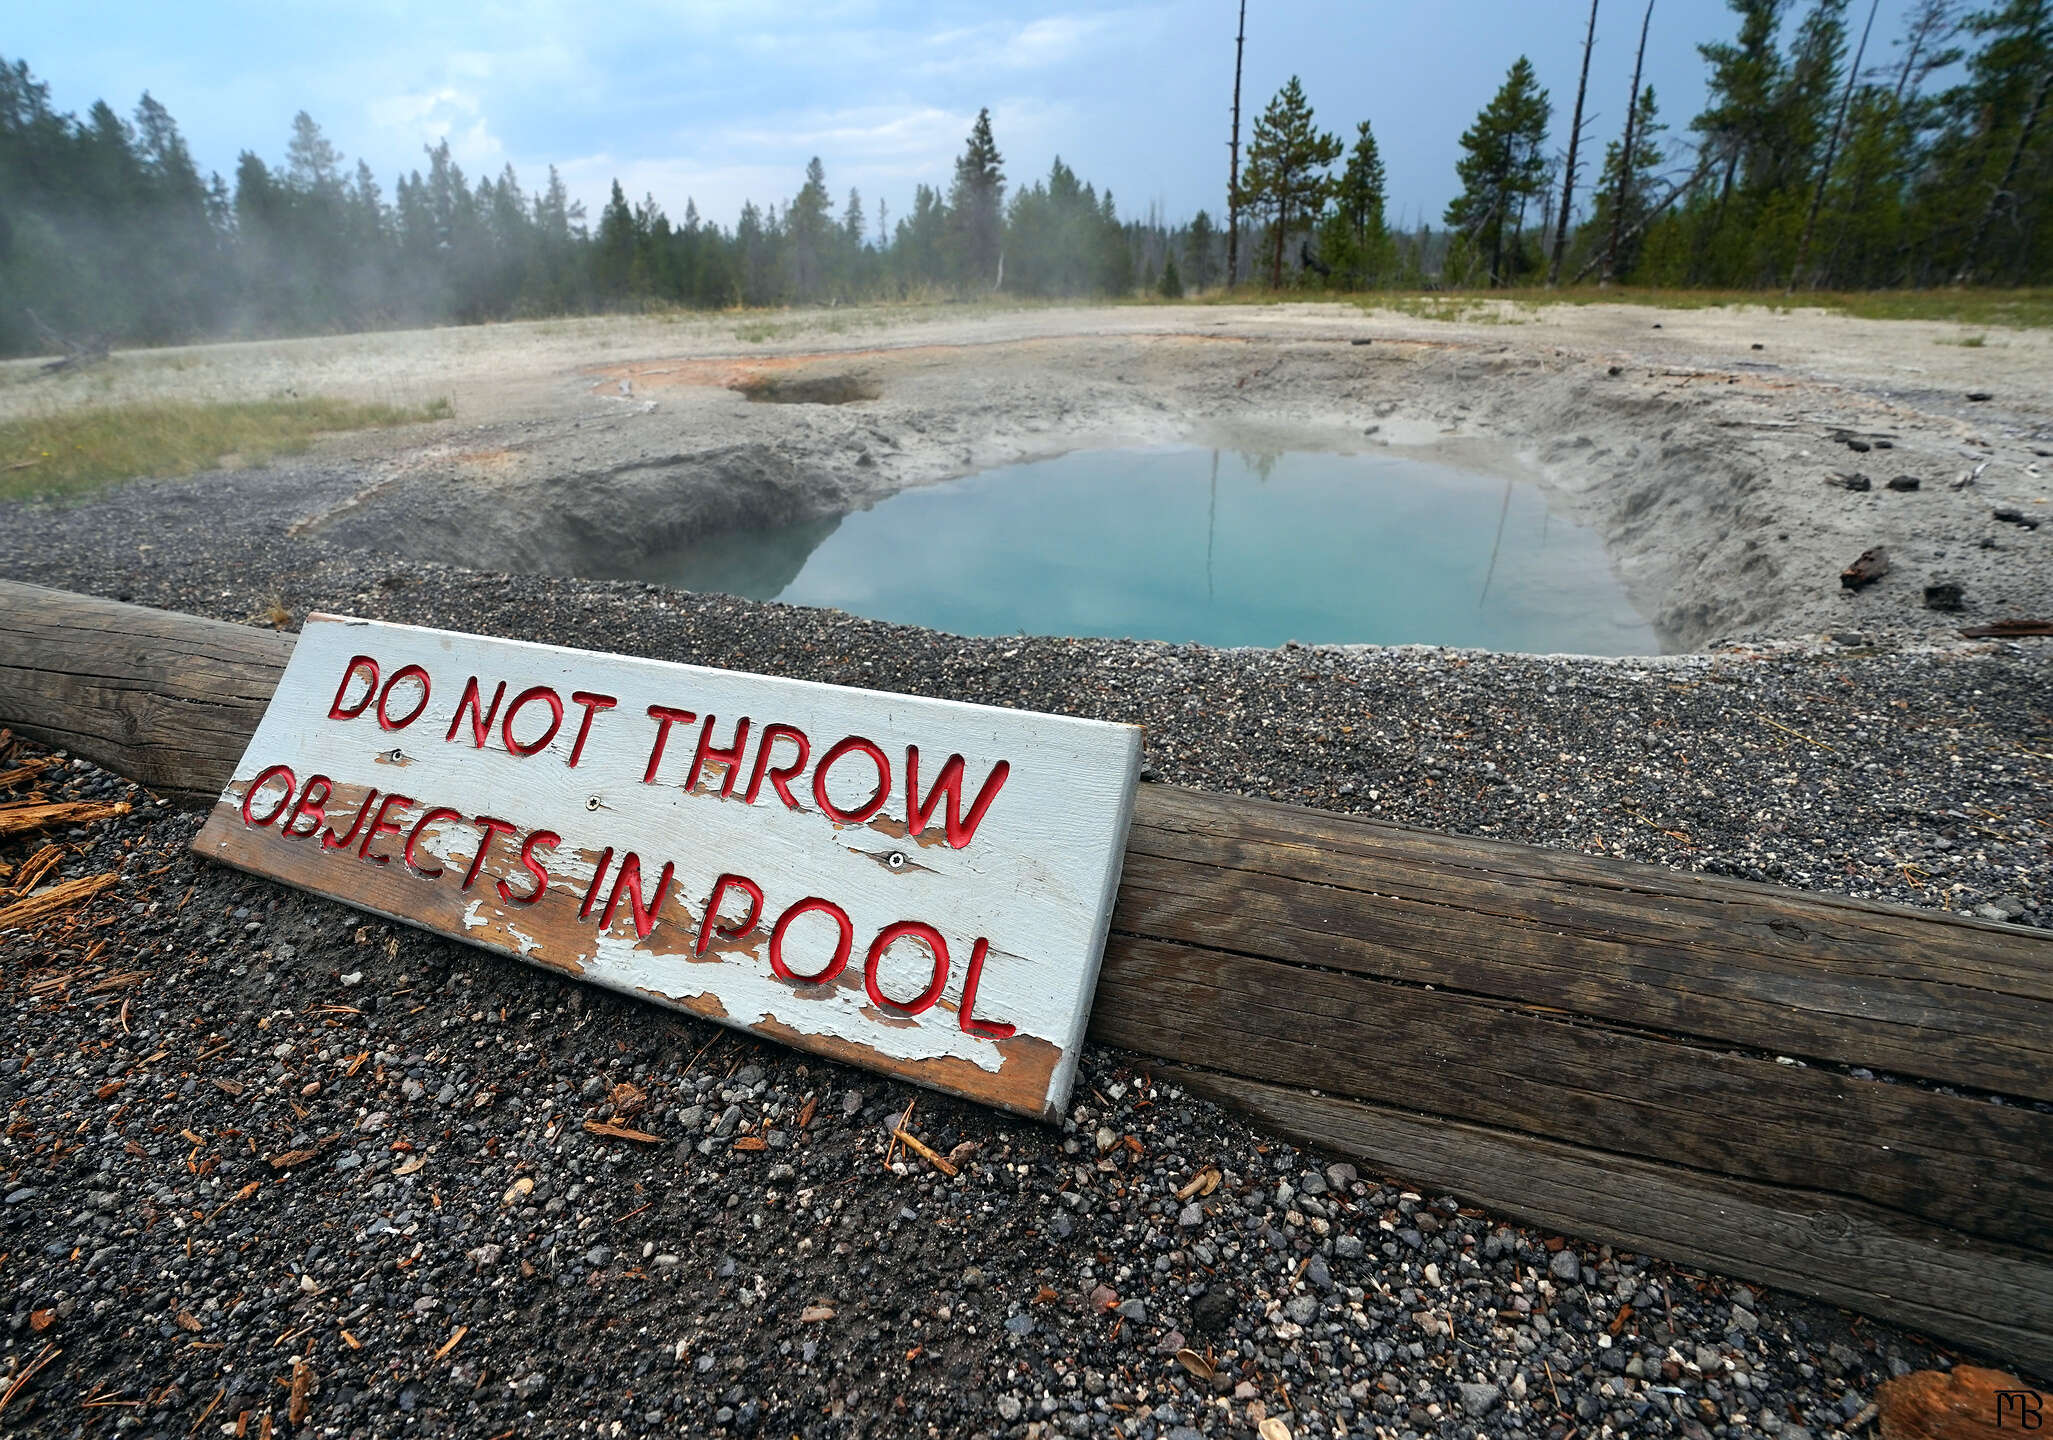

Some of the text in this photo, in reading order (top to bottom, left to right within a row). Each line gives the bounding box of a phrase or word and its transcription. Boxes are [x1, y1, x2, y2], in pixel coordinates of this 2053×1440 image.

[328, 655, 1010, 849] DO NOT THROW
[242, 764, 1017, 1040] OBJECTS IN POOL
